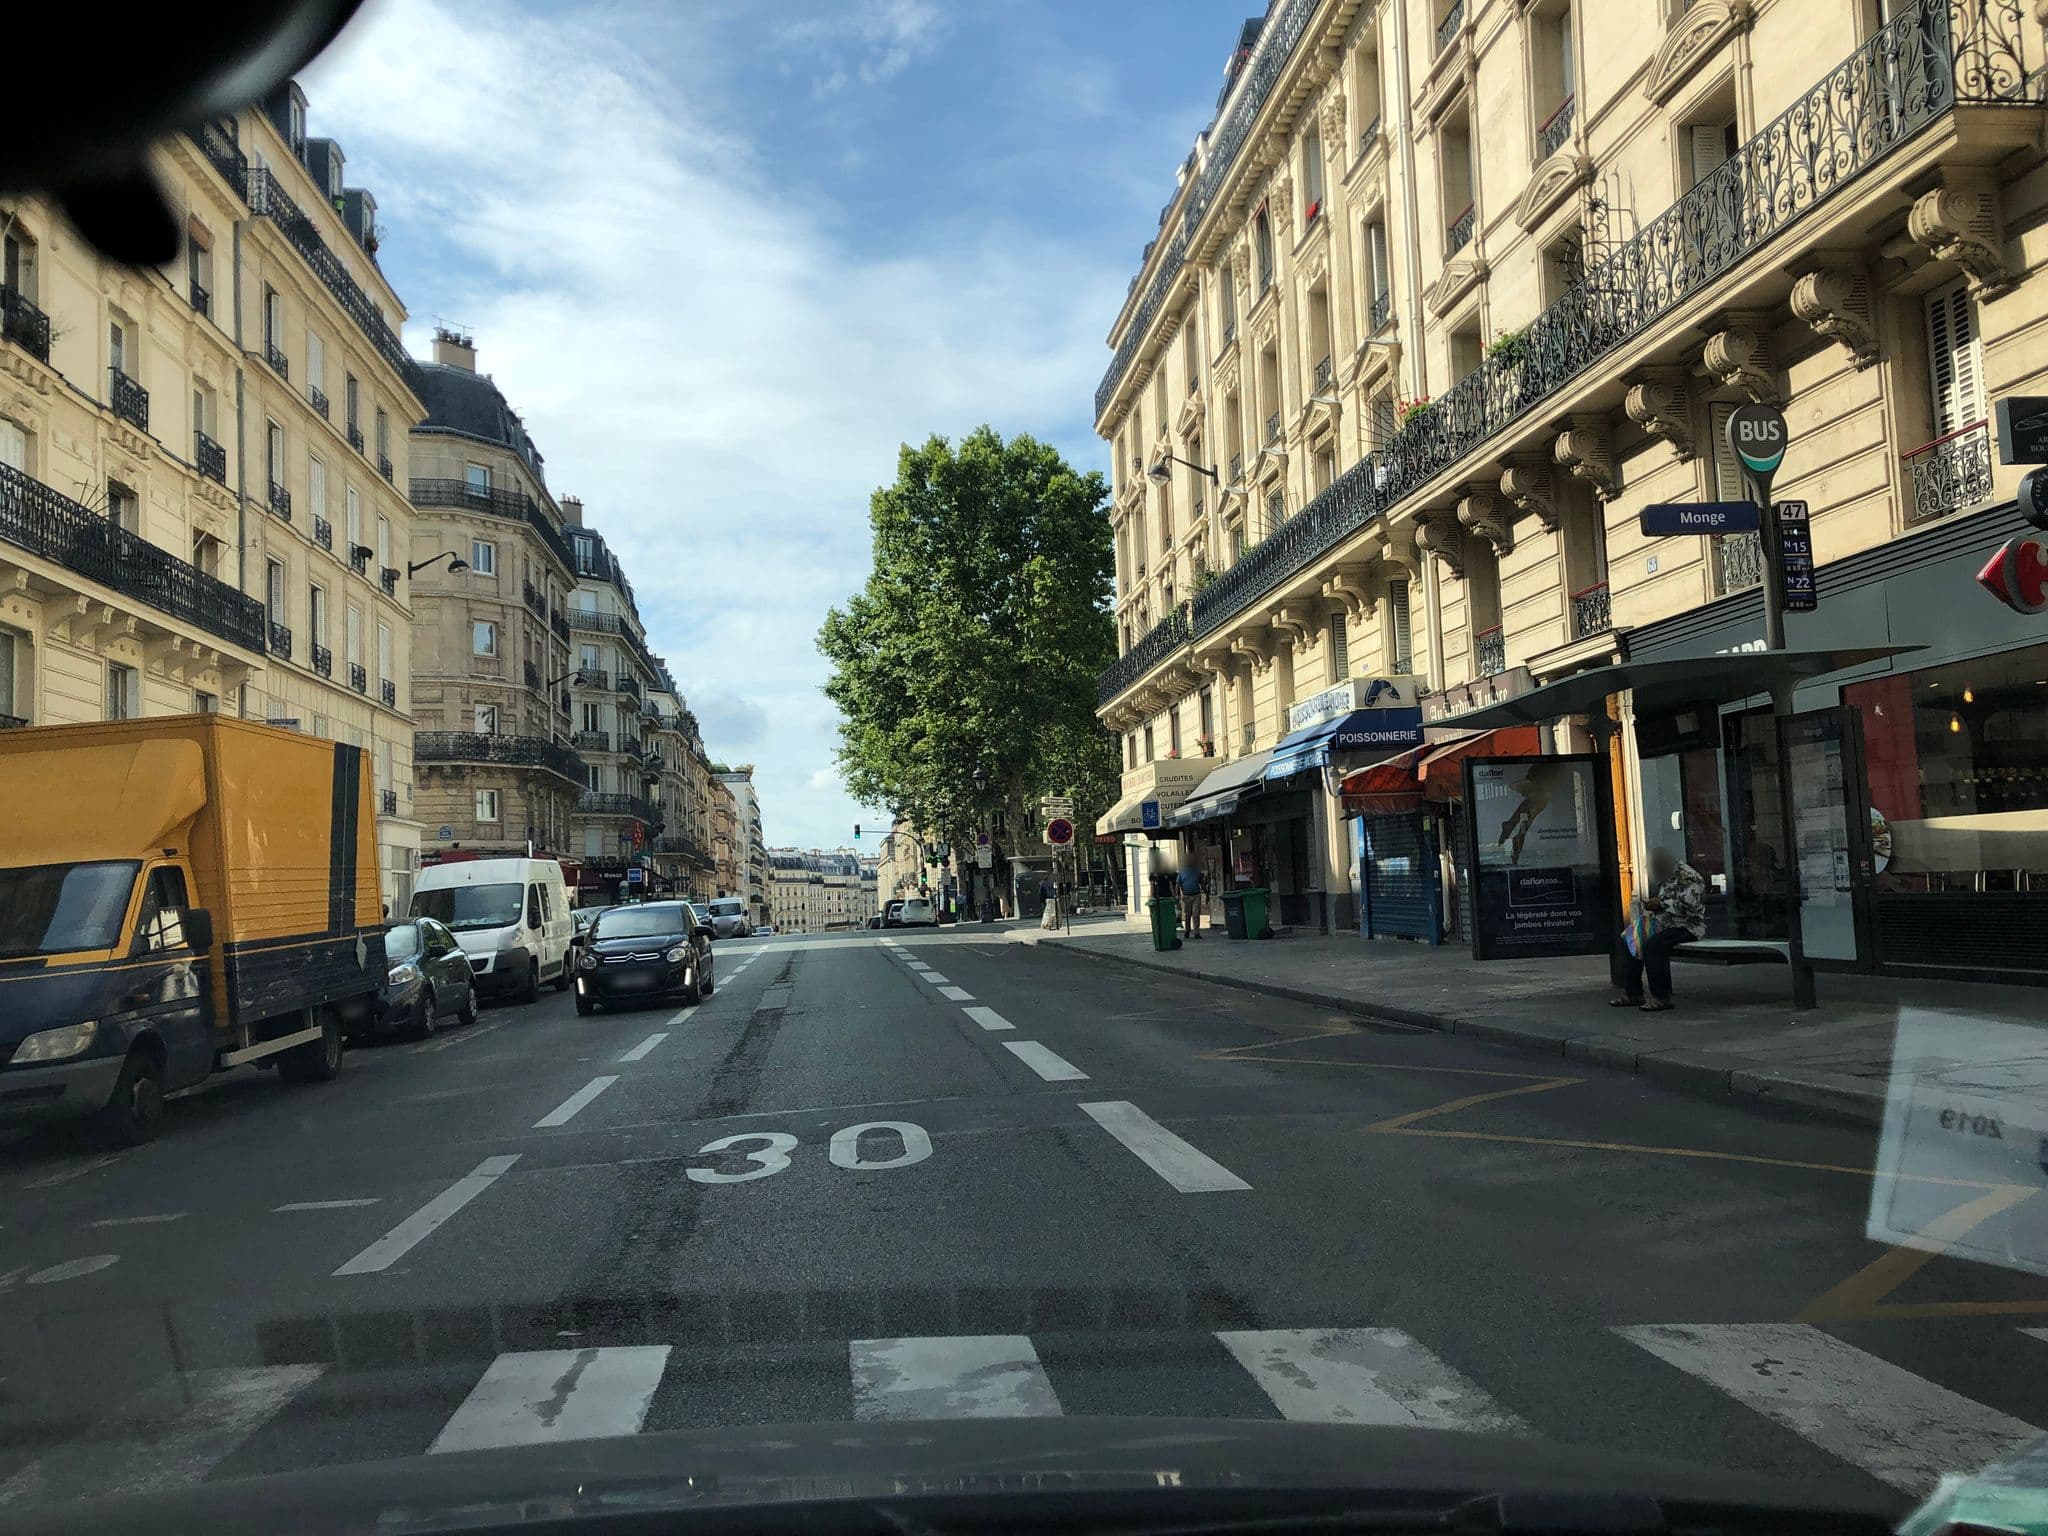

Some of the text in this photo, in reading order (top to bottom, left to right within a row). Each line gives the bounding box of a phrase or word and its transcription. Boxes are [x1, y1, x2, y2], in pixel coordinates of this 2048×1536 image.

[1739, 420, 1780, 442] BUS
[1783, 505, 1802, 518] 47
[1680, 512, 1726, 526] Monge
[1784, 541, 1807, 553] N15
[1787, 577, 1810, 589] N22
[1339, 730, 1418, 744] POISSONNERIE
[1159, 775, 1194, 783] CRUDITES
[1478, 768, 1504, 778] daflon
[1505, 911, 1515, 920] La
[1549, 909, 1568, 918] dont
[685, 1120, 933, 1184] 30
